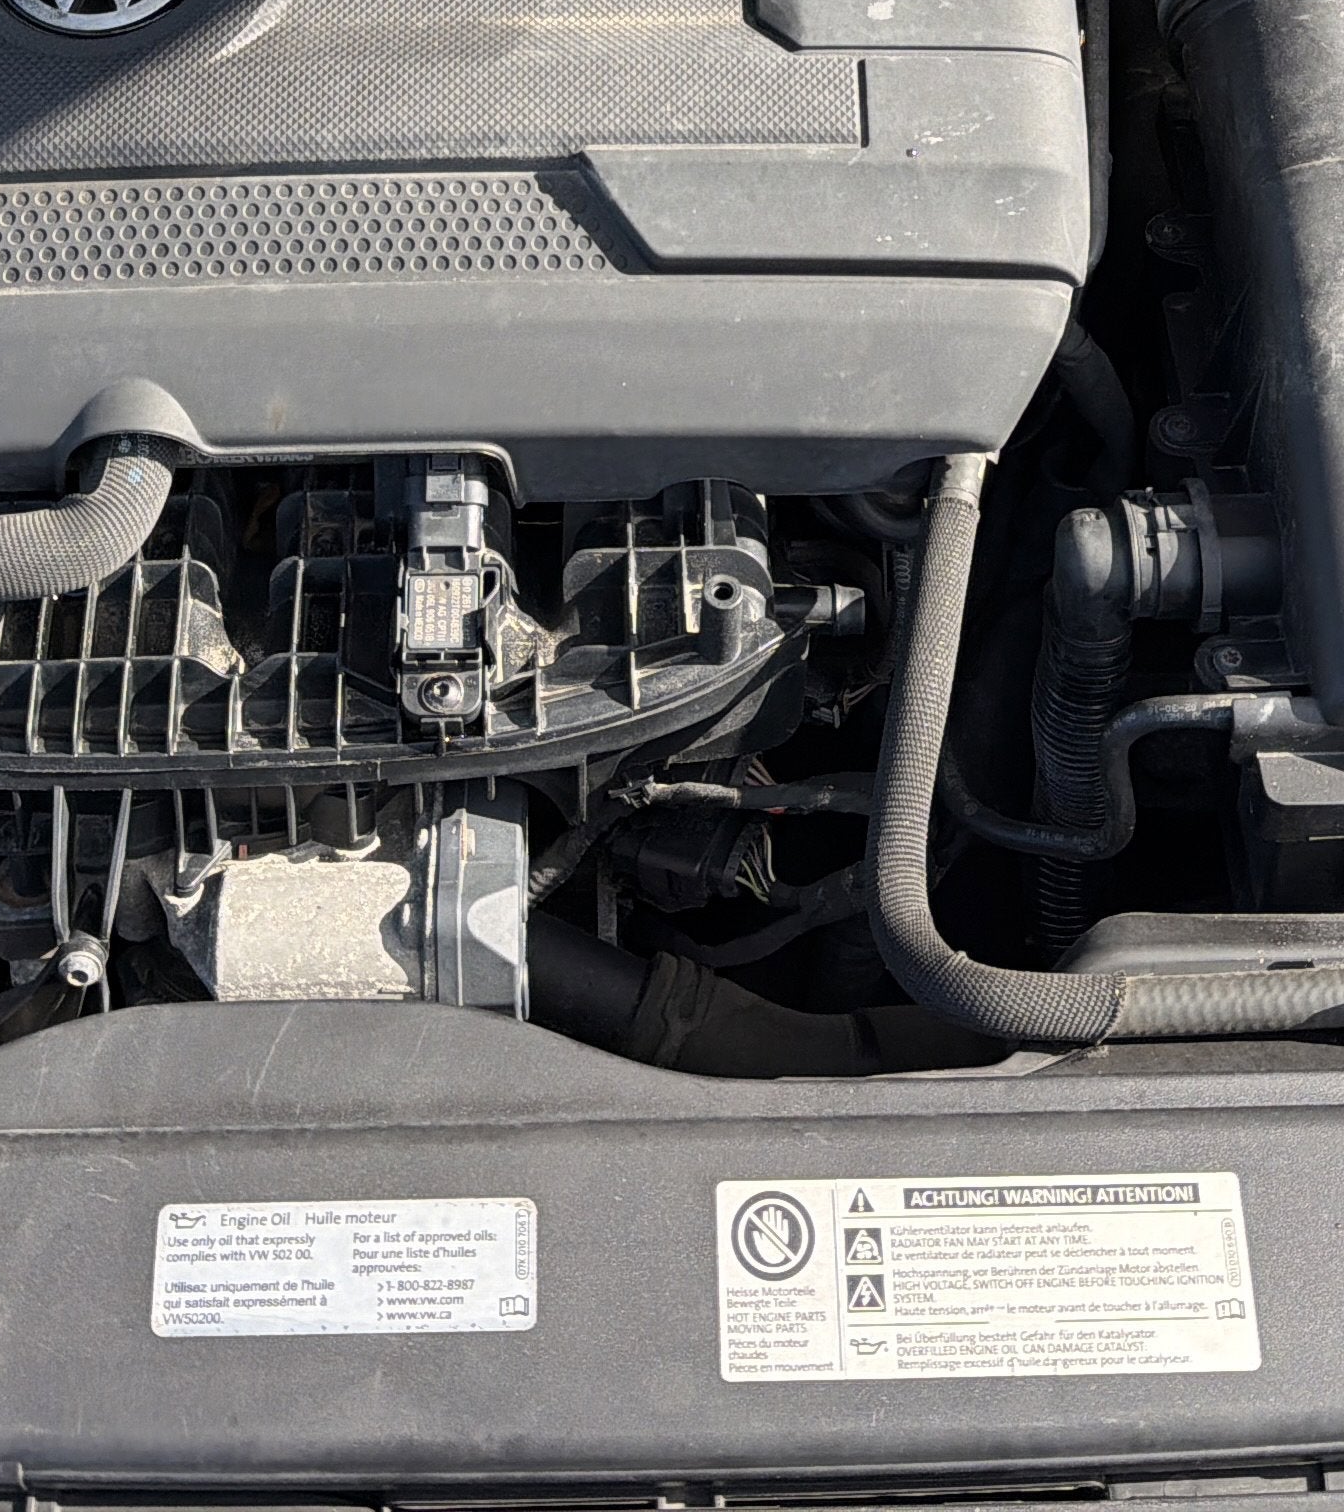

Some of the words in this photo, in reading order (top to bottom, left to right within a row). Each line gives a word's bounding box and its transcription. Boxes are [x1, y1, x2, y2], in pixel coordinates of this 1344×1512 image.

[910, 1190, 1000, 1207] ACHTUNG!
[1003, 1188, 1093, 1204] WARNING!
[1096, 1185, 1195, 1203] ATTENTION!
[220, 1213, 268, 1230] Engine
[271, 1212, 291, 1226] Oil
[305, 1212, 342, 1225] Huile
[345, 1212, 397, 1224] moteur
[518, 1219, 527, 1237] 706
[973, 1224, 997, 1235] kann
[999, 1224, 1042, 1236] jederzeit
[167, 1237, 188, 1247] Use
[191, 1237, 216, 1249] only
[219, 1235, 232, 1246] oil
[236, 1235, 260, 1245] that
[262, 1234, 316, 1247] expressly
[353, 1232, 371, 1243] For
[373, 1234, 381, 1243] a
[384, 1232, 401, 1242] list
[403, 1231, 417, 1242] of
[418, 1230, 472, 1246] approved
[473, 1231, 497, 1241] oils:
[891, 1238, 941, 1248] RADIATOR
[943, 1238, 964, 1247] FAN
[967, 1237, 989, 1246] MAY
[992, 1236, 1023, 1246] START
[1024, 1236, 1037, 1246] AT
[1039, 1236, 1061, 1245] ANY
[353, 1249, 379, 1260] Pour
[382, 1249, 403, 1259] une
[406, 1247, 431, 1258] liste
[518, 1240, 527, 1256] 010
[891, 1251, 902, 1261] Le
[904, 1250, 959, 1260] ventilateur
[961, 1249, 974, 1259] de
[976, 1249, 1022, 1259] radiateur
[1024, 1249, 1047, 1260] peut
[1050, 1249, 1062, 1258] se
[1119, 1246, 1126, 1256] à
[1128, 1246, 1149, 1256] tout
[166, 1251, 217, 1265] complies
[220, 1251, 246, 1261] with
[249, 1251, 269, 1261] VW
[272, 1250, 292, 1260] 502
[352, 1263, 422, 1276] approuvées:
[973, 1268, 988, 1277] vor
[991, 1266, 1037, 1277] Berühren
[1039, 1266, 1055, 1276] der
[1057, 1265, 1117, 1276] Zündanlage
[1119, 1263, 1151, 1273] Motor
[164, 1282, 207, 1293] Utilisez
[210, 1282, 280, 1294] uniquement
[283, 1280, 297, 1290] de
[892, 1281, 920, 1291] HIGH
[973, 1279, 1013, 1289] SWITCH
[1015, 1279, 1033, 1288] OFF
[1037, 1278, 1076, 1288] ENGINE
[1078, 1276, 1117, 1288] BEFORE
[1119, 1275, 1175, 1286] TOUCHING
[1177, 1274, 1225, 1285] IGNITION
[726, 1287, 759, 1297] Heisse
[762, 1287, 816, 1297] Motorteile
[163, 1298, 181, 1310] qui
[185, 1297, 230, 1308] satisfait
[320, 1294, 328, 1306] à
[387, 1295, 464, 1306] www.vw.com
[727, 1299, 771, 1311] Bewegte
[773, 1298, 797, 1307] Teile
[894, 1306, 926, 1316] Haute
[1007, 1304, 1016, 1313] le
[1018, 1304, 1056, 1313] moteur
[1057, 1303, 1086, 1312] avant
[1089, 1302, 1101, 1312] de
[1103, 1302, 1141, 1312] toucher
[386, 1310, 452, 1320] www.vw.ca
[727, 1313, 749, 1322] HOT
[753, 1312, 792, 1322] ENGINE
[795, 1311, 826, 1321] PARTS
[727, 1324, 773, 1334] MOVING
[776, 1323, 807, 1333] PARTS
[759, 1338, 771, 1348] du
[773, 1339, 809, 1348] moteur
[896, 1333, 913, 1344] Bei
[979, 1331, 1017, 1341] besteht
[1020, 1331, 1055, 1341] Gefahr
[1058, 1330, 1074, 1340] für
[1077, 1331, 1096, 1340] den
[896, 1346, 957, 1356] OVERFILLED
[959, 1345, 998, 1355] ENGINE
[1001, 1345, 1018, 1354] OIL
[1023, 1344, 1045, 1353] CAN
[1047, 1343, 1094, 1353] DAMAGE
[775, 1362, 834, 1372] mouvement
[897, 1358, 961, 1372] Remplissage
[964, 1357, 1004, 1368] excessif
[1101, 1356, 1124, 1367] pour
[1127, 1355, 1136, 1364] le
